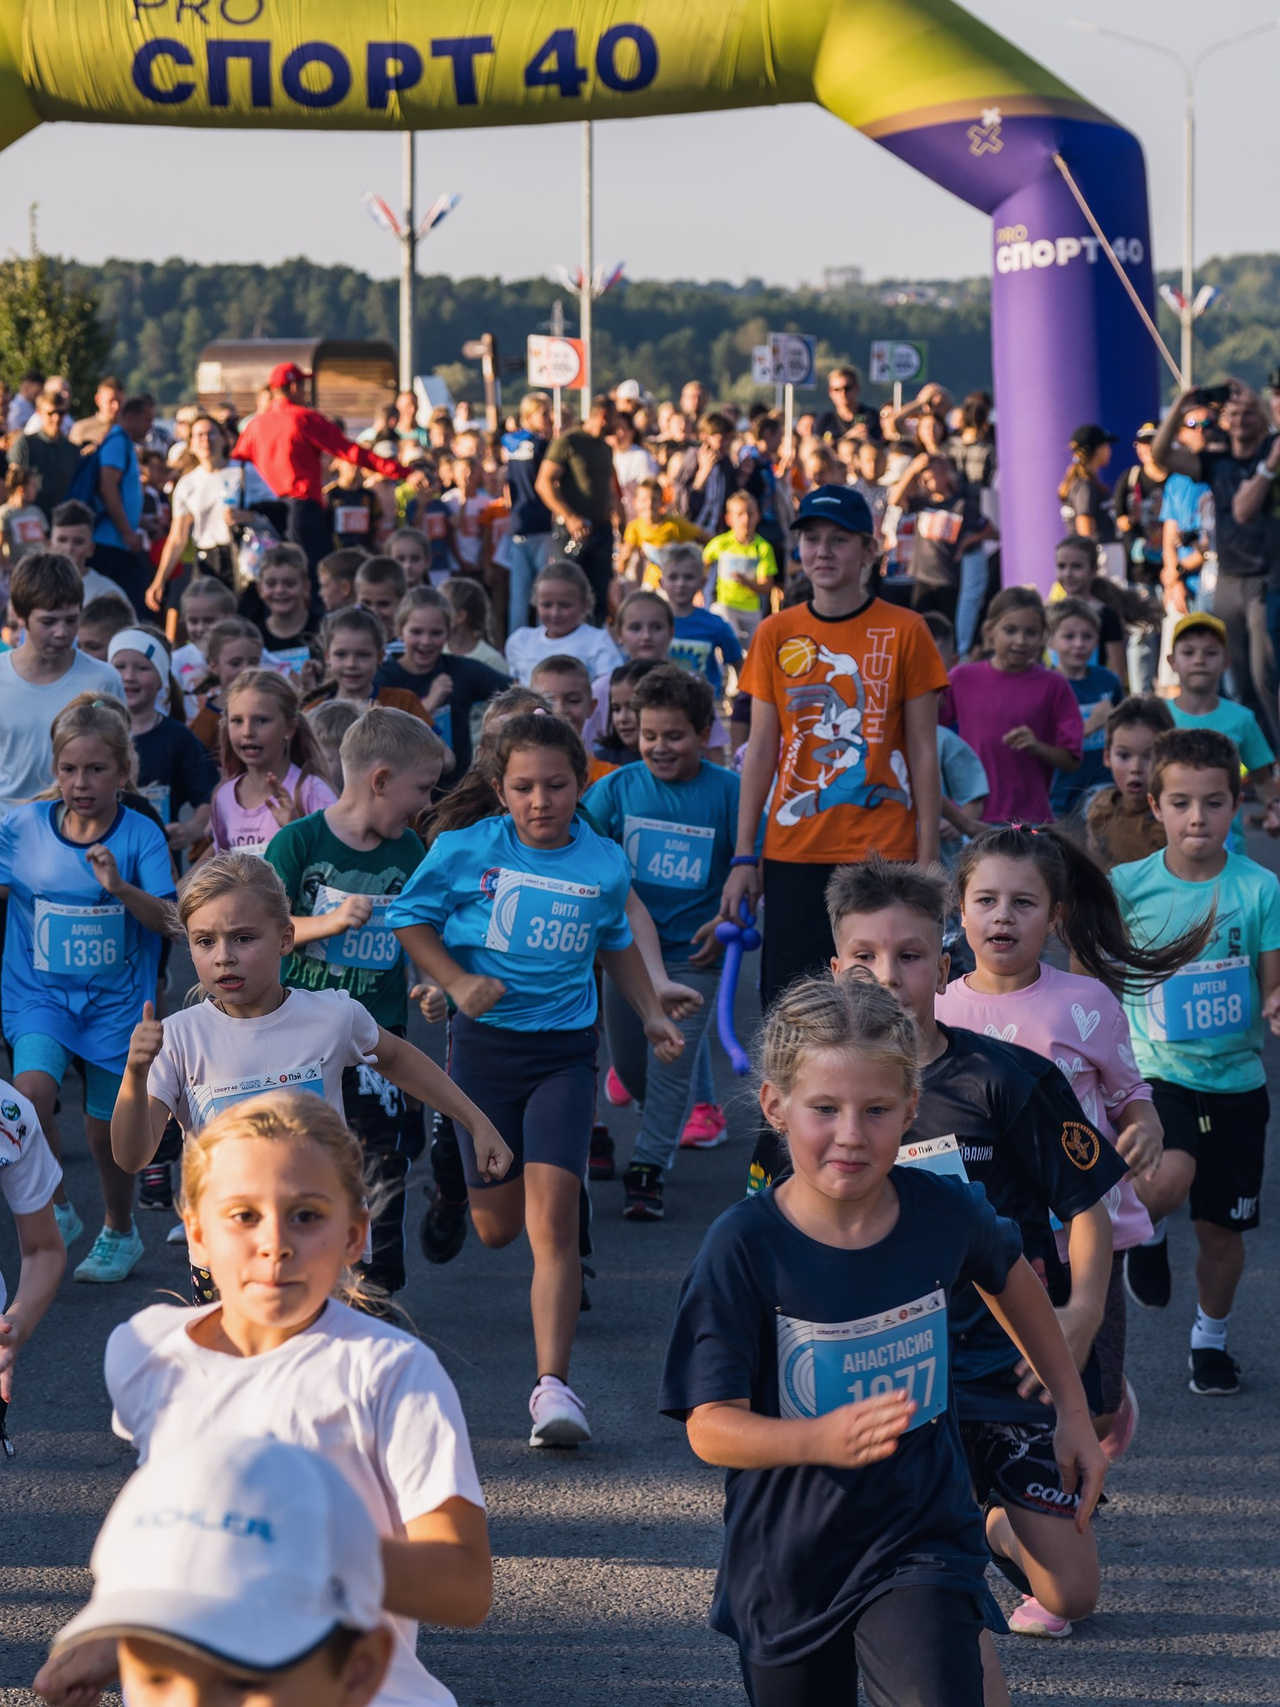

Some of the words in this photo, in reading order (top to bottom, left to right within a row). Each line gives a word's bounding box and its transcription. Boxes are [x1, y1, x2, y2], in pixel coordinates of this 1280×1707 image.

[132, 35, 495, 107] СПОРТ
[524, 22, 660, 97] 40
[996, 237, 1099, 274] СПОРТ
[1111, 237, 1144, 265] 40
[647, 852, 702, 883] 4544
[551, 901, 580, 918] ВИТА
[71, 924, 103, 936] АРИНА
[342, 929, 397, 962] 5033
[526, 916, 592, 953] 3365
[62, 938, 117, 967] 1336
[1192, 979, 1227, 996] АРТЕМ
[1182, 994, 1242, 1031] 1858
[288, 1073, 302, 1081] Пэй
[842, 1328, 934, 1374] АНАСТАСИЯ
